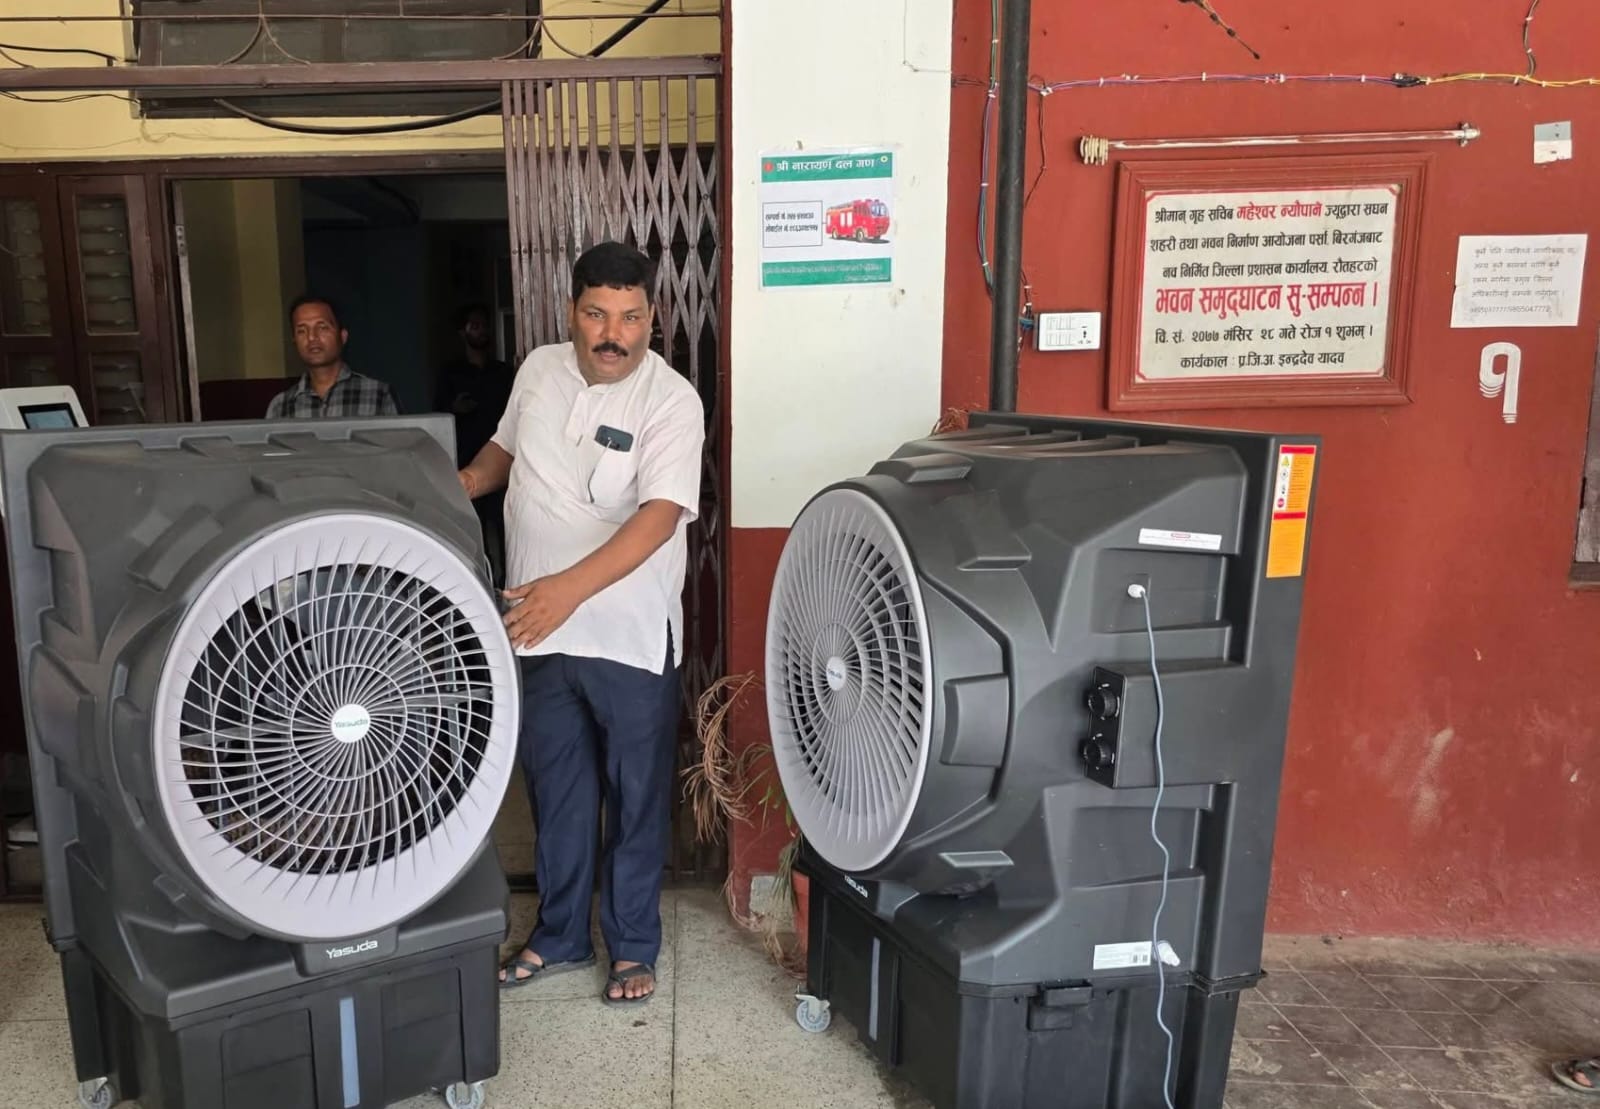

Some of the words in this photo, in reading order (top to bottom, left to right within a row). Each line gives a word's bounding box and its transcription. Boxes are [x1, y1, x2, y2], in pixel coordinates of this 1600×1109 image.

[776, 160, 788, 172] श्री
[792, 160, 832, 172] नारायण
[835, 159, 853, 170] दल
[856, 158, 875, 169] गण
[1155, 207, 1187, 225] श्रीमान्
[1189, 209, 1205, 225] गृह
[1237, 201, 1278, 220] महेश्वर
[1363, 202, 1389, 217] सघन
[1150, 235, 1177, 252] शहरी
[1179, 237, 1199, 250] तथा
[1201, 236, 1224, 249] भवन
[1226, 232, 1259, 248] निर्माण
[1262, 231, 1306, 247] आयोजना
[1162, 266, 1178, 279] नव
[1180, 262, 1210, 278] निर्मित
[1212, 261, 1245, 277] जिल्ला
[1247, 262, 1282, 277] प्रशासन
[1155, 287, 1196, 314] भवन
[1191, 329, 1220, 342] २०७७
[1223, 325, 1254, 342] मंसिर
[1260, 328, 1275, 340] २८
[1279, 323, 1297, 340] गते
[1300, 323, 1322, 340] रोज
[1336, 325, 1366, 341] शुभम्
[1180, 353, 1229, 368] कार्यकाल
[1278, 349, 1315, 367] इन्द्रदेव
[1317, 351, 1346, 365] यादव
[325, 939, 379, 960] Yasuda
